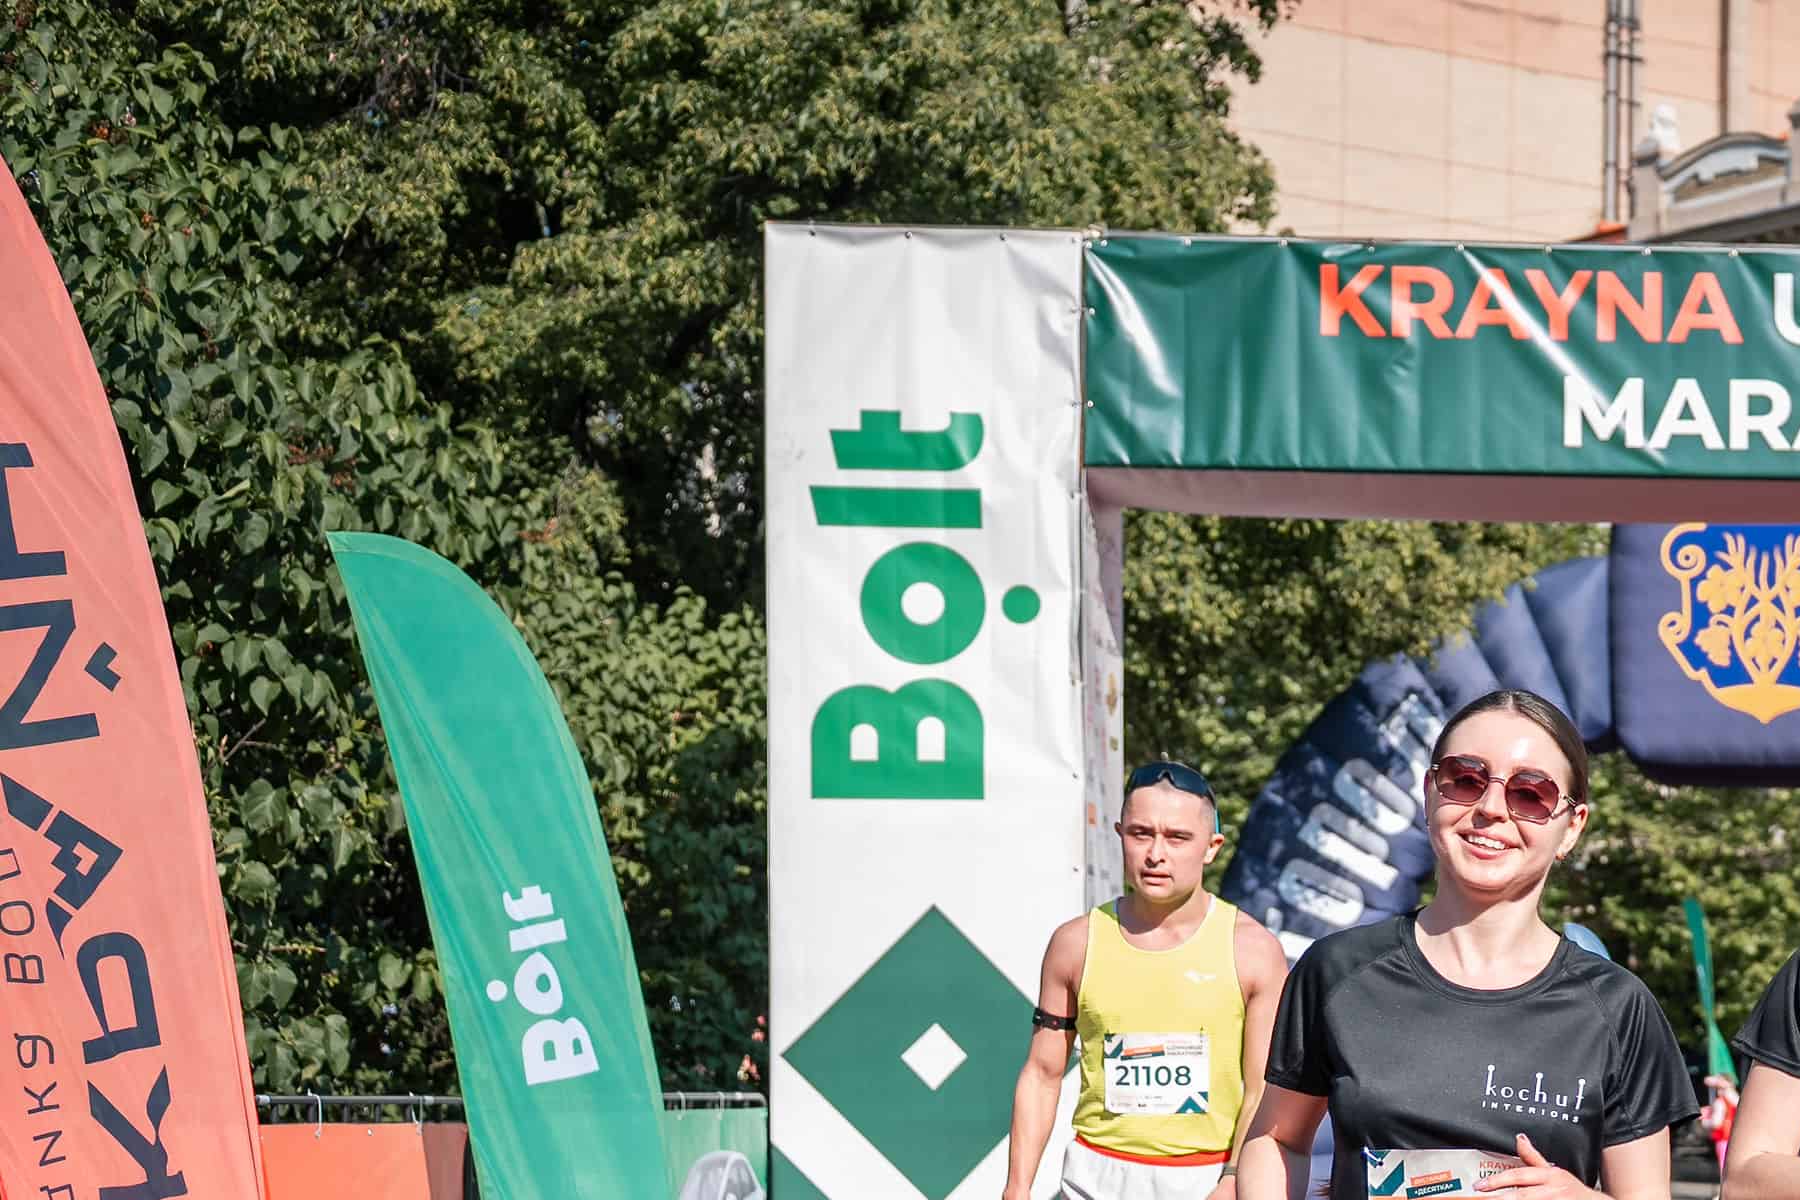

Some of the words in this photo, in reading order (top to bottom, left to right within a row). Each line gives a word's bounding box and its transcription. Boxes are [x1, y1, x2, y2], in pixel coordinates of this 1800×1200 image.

[1319, 263, 1743, 344] KRAYNA
[809, 410, 1041, 800] Bolt
[1115, 1065, 1192, 1086] 21108
[1485, 1064, 1586, 1110] kochut
[1482, 1101, 1579, 1123] INTERIORS
